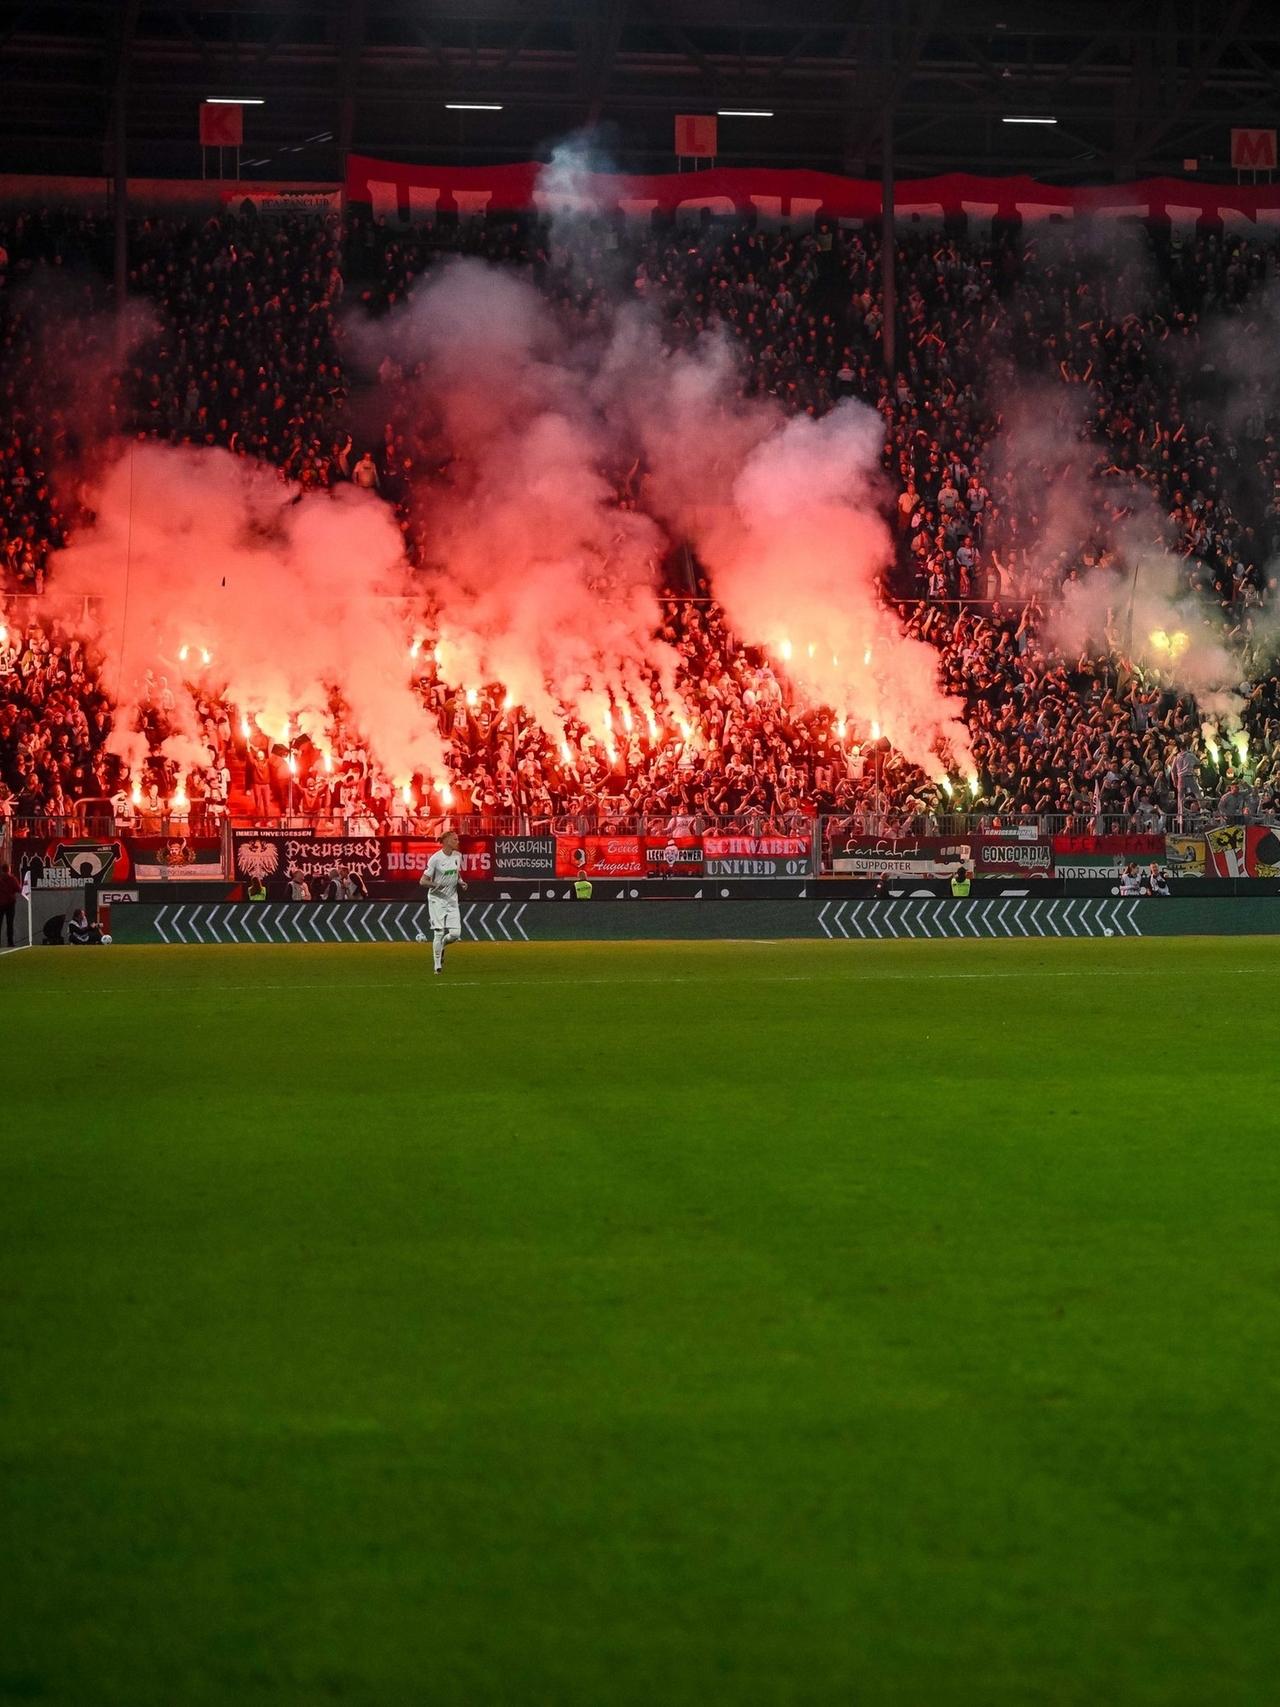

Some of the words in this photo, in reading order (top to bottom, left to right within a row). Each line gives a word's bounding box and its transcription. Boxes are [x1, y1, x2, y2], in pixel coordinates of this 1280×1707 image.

[687, 119, 705, 152] L
[1235, 131, 1274, 165] M
[706, 838, 807, 854] SCHWABEN
[387, 852, 491, 871] DISSNTS
[648, 850, 664, 861] LECH
[678, 850, 702, 861] POWER
[983, 846, 1050, 863] CONCORDIA
[43, 867, 71, 879] FREIE
[591, 858, 642, 875] Augusta
[707, 860, 776, 875] UNITED
[785, 860, 808, 874] 07
[856, 861, 911, 871] SUPPORTER
[36, 878, 94, 888] AUGSBURGER
[102, 893, 133, 903] FCA
